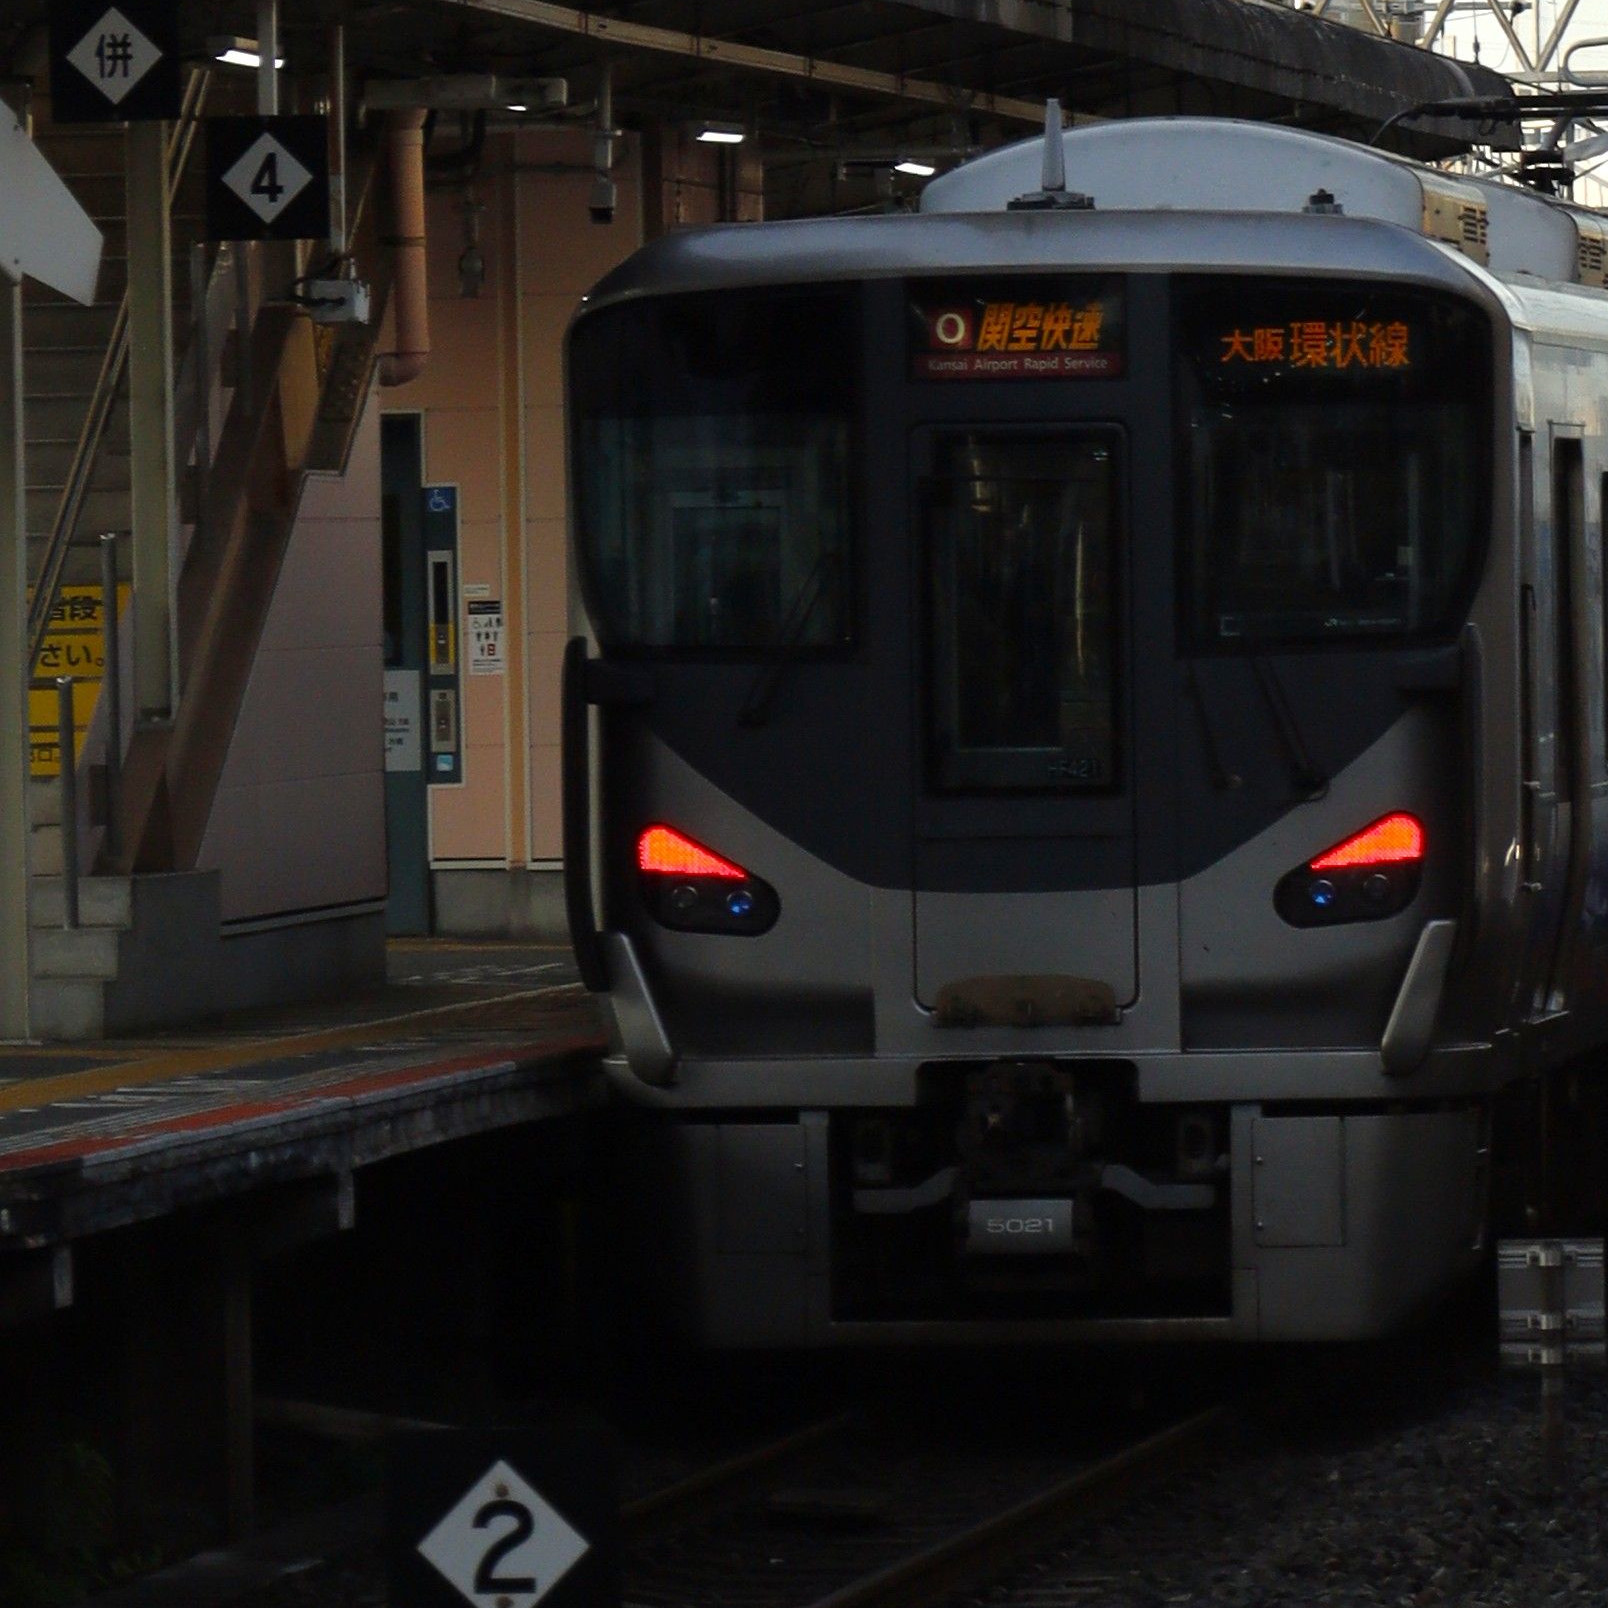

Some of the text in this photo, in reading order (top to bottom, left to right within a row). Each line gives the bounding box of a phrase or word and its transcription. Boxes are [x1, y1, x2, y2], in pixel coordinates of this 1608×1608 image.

[96, 33, 134, 79] 併
[251, 153, 284, 203] 4
[976, 301, 1103, 351] 関空快速
[928, 357, 1108, 372] Kansai Airport Rapid Service
[986, 1218, 1054, 1233] 5021
[471, 1498, 537, 1595] 2
